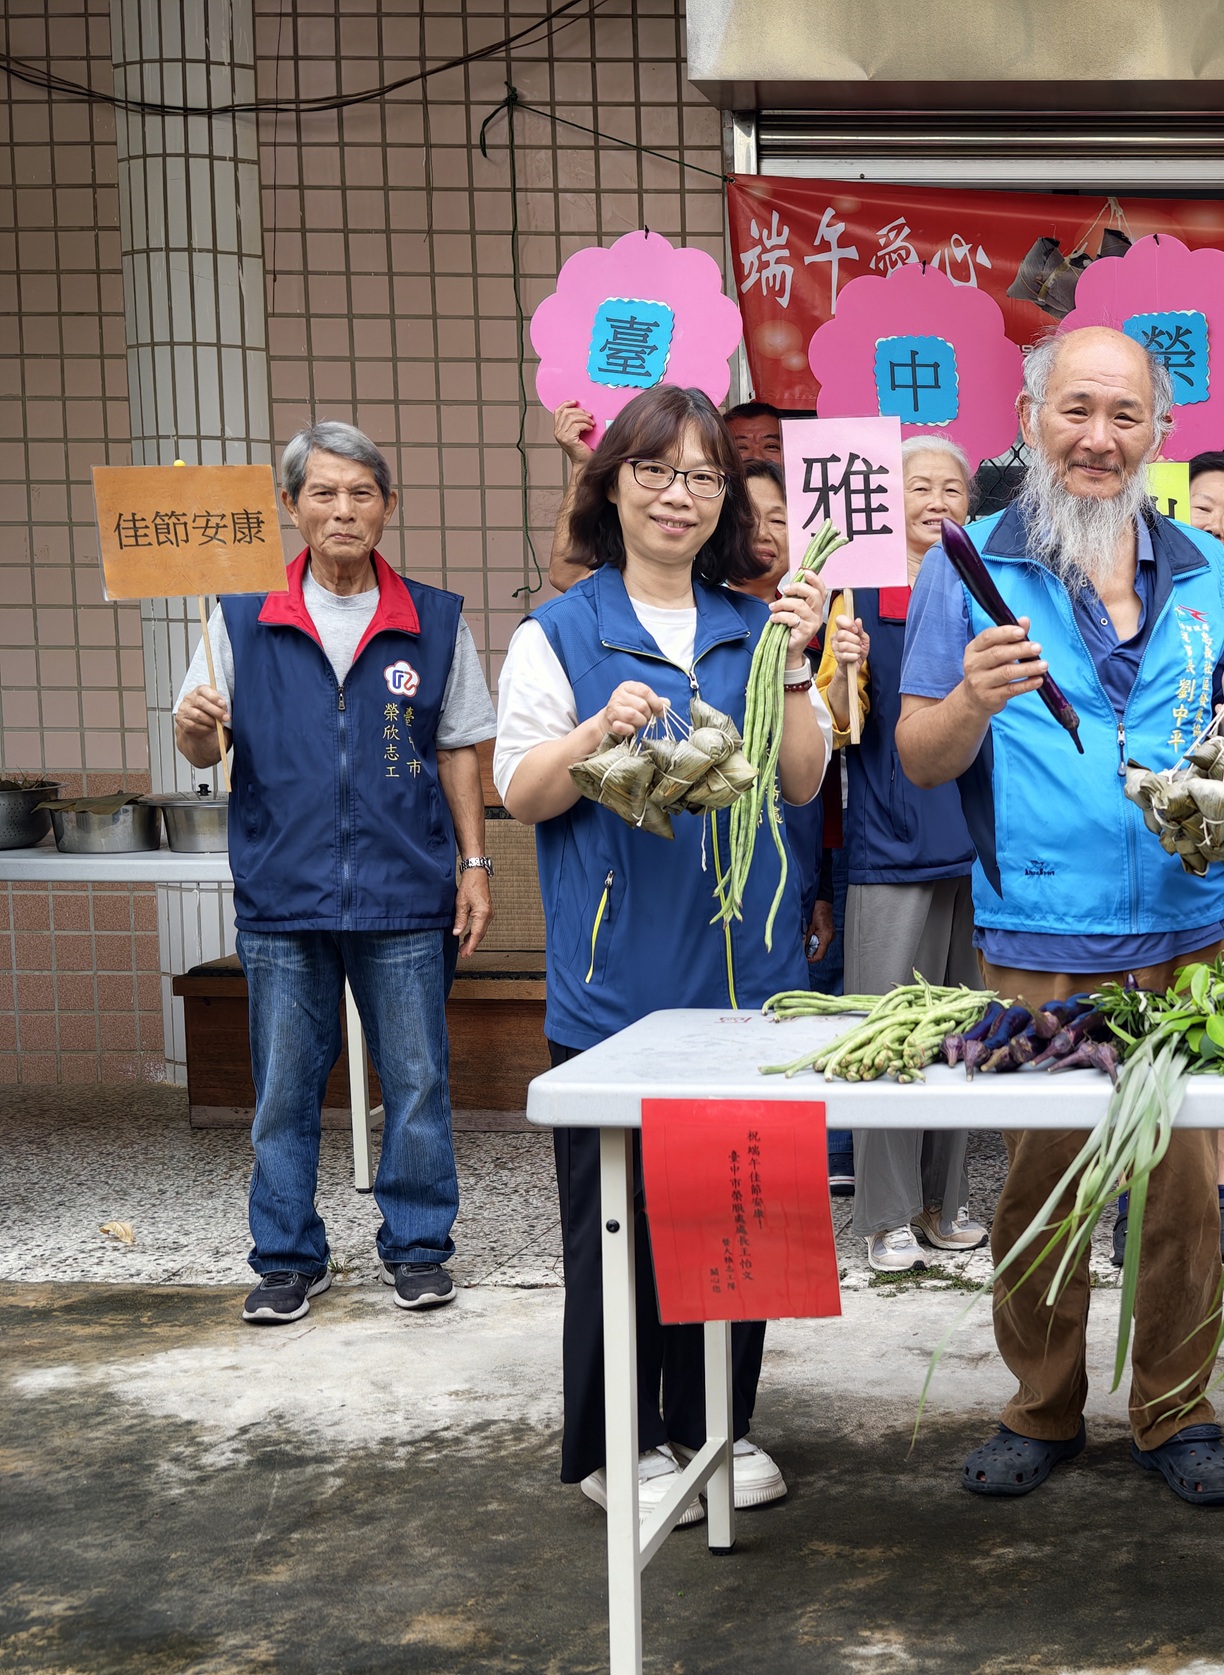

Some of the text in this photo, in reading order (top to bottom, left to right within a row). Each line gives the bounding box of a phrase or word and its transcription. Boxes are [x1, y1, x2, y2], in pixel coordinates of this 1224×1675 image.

[597, 316, 661, 378] 臺
[1141, 325, 1196, 387] 榮
[889, 350, 941, 413] 中
[802, 452, 893, 542] 雅
[113, 508, 266, 550] 佳節安康
[382, 702, 400, 778] 榮欣志工
